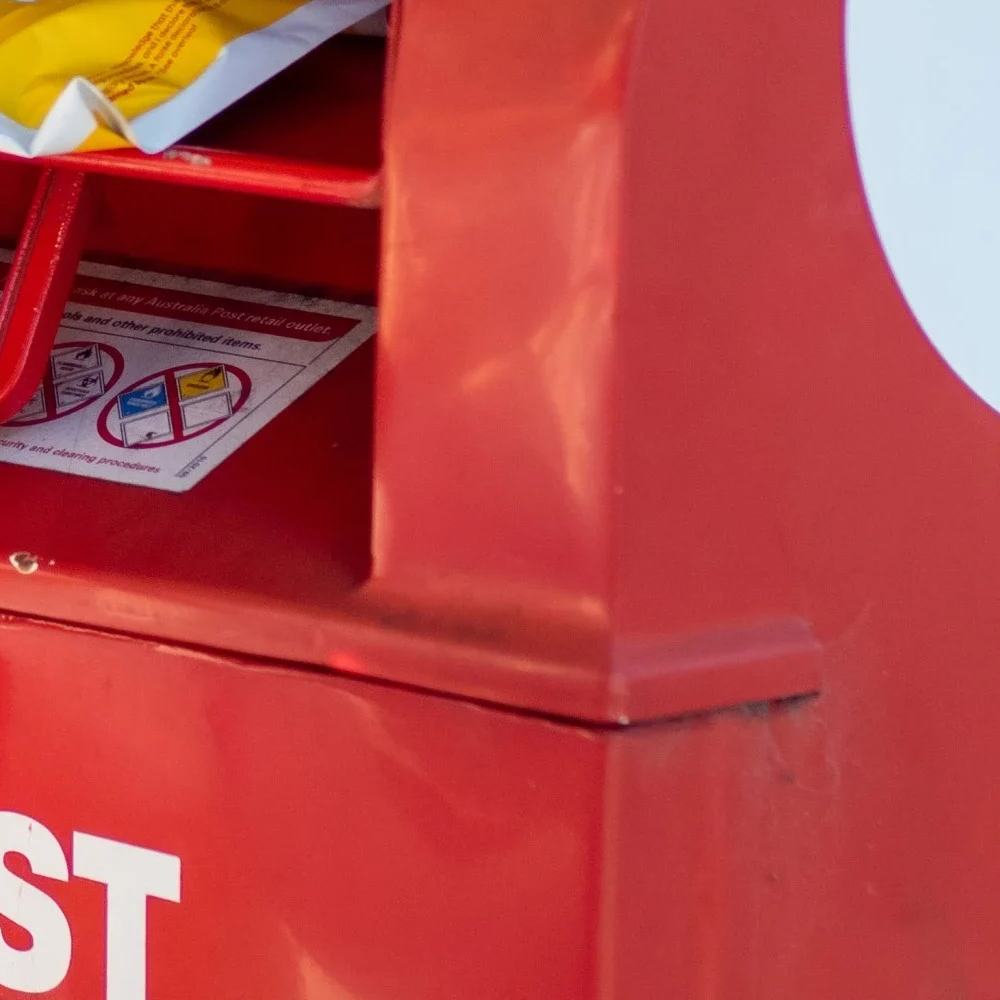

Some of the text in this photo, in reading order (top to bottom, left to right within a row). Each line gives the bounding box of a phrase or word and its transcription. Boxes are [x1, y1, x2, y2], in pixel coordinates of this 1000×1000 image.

[100, 289, 118, 301] at
[116, 293, 145, 307] any
[143, 295, 212, 316] Australia
[210, 306, 246, 321] Post
[244, 312, 286, 328] retail
[285, 320, 333, 336] outlet.
[83, 313, 112, 327] and
[111, 319, 150, 334] other
[148, 324, 222, 345] prohibited
[221, 337, 262, 351] items.
[28, 443, 54, 455] and
[52, 448, 96, 466] clearing
[94, 455, 161, 475] procedures
